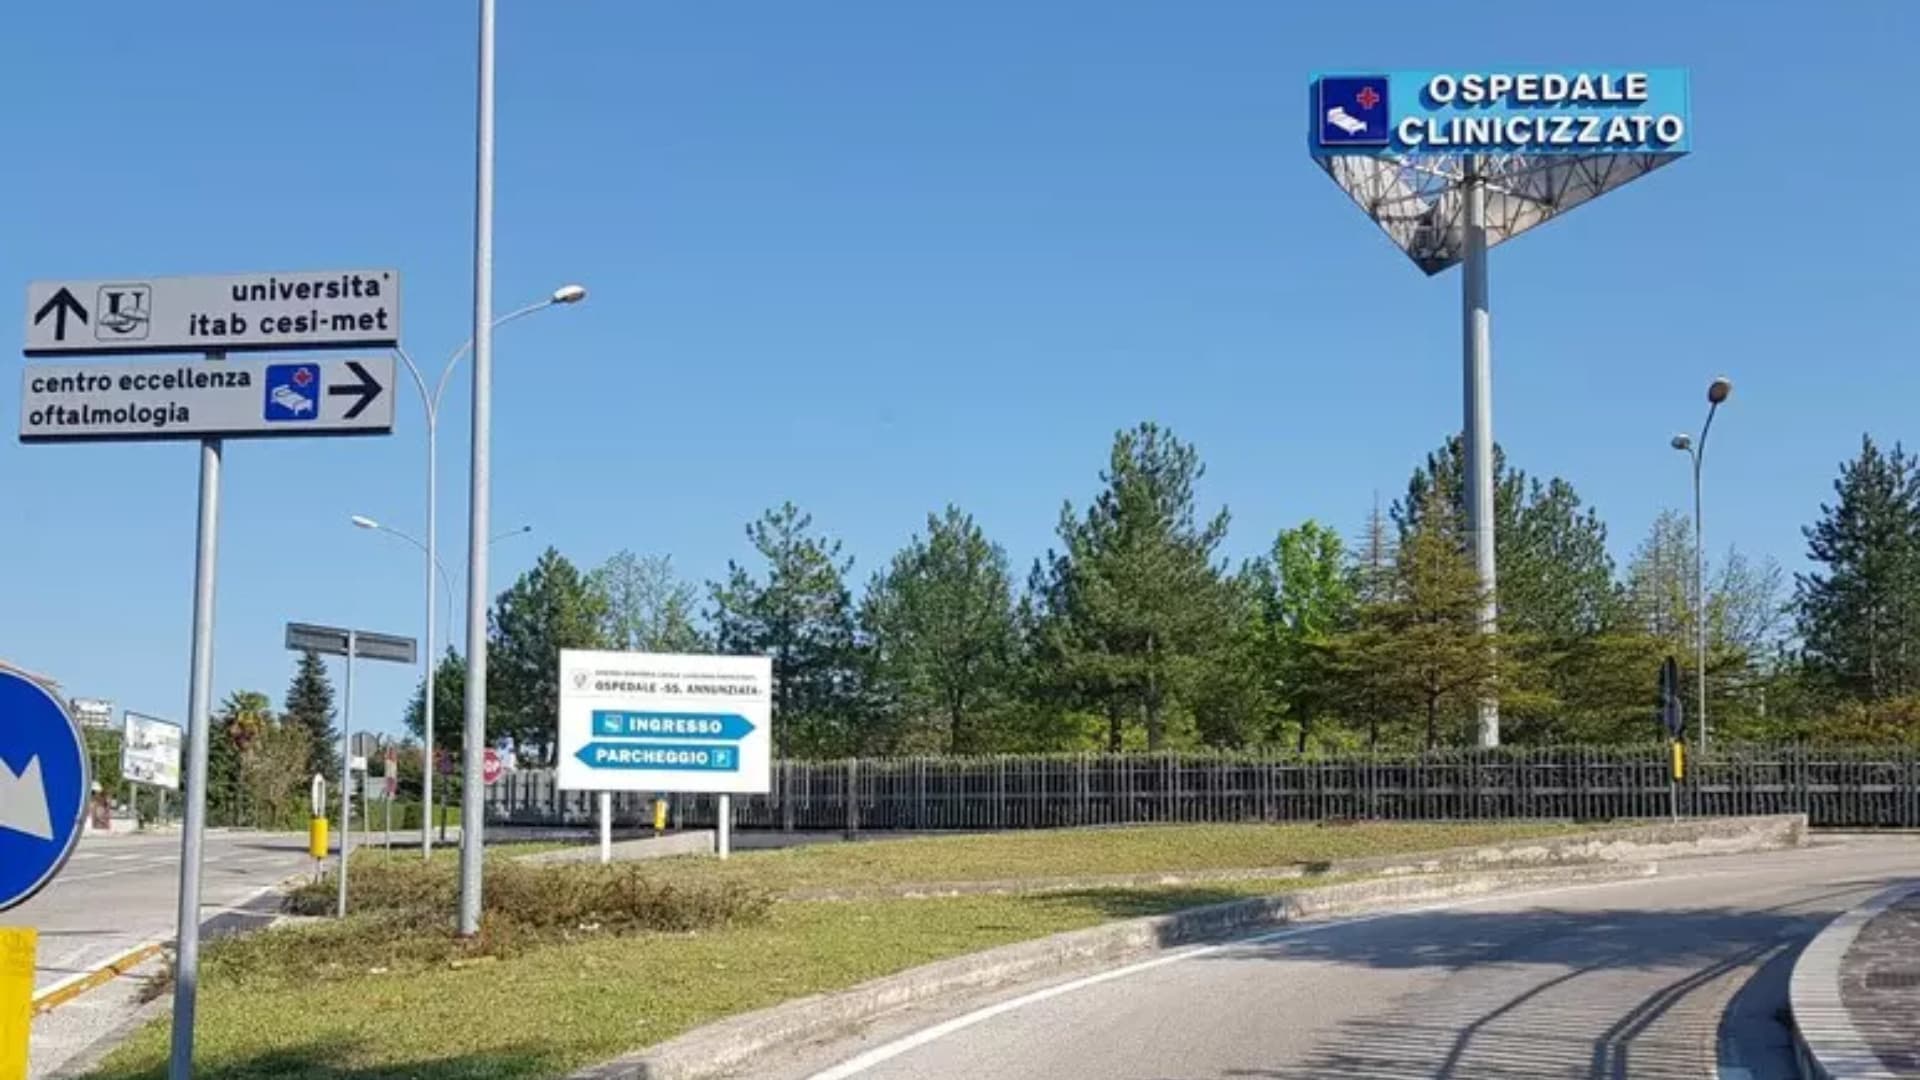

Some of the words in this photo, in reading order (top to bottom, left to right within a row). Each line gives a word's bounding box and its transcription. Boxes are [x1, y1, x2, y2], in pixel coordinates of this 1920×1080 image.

[1429, 73, 1648, 103] OSPEDALE
[1398, 114, 1685, 146] CLINICIZZATO
[190, 313, 247, 337] itab
[260, 308, 389, 334] cesi-met
[31, 372, 113, 393] centro
[118, 368, 252, 391] eccellenza
[29, 402, 190, 427] oftalmologia
[595, 680, 656, 694] OSPEDALE
[628, 717, 723, 734] INGRESSO
[595, 748, 709, 765] PARCHEGGIO
